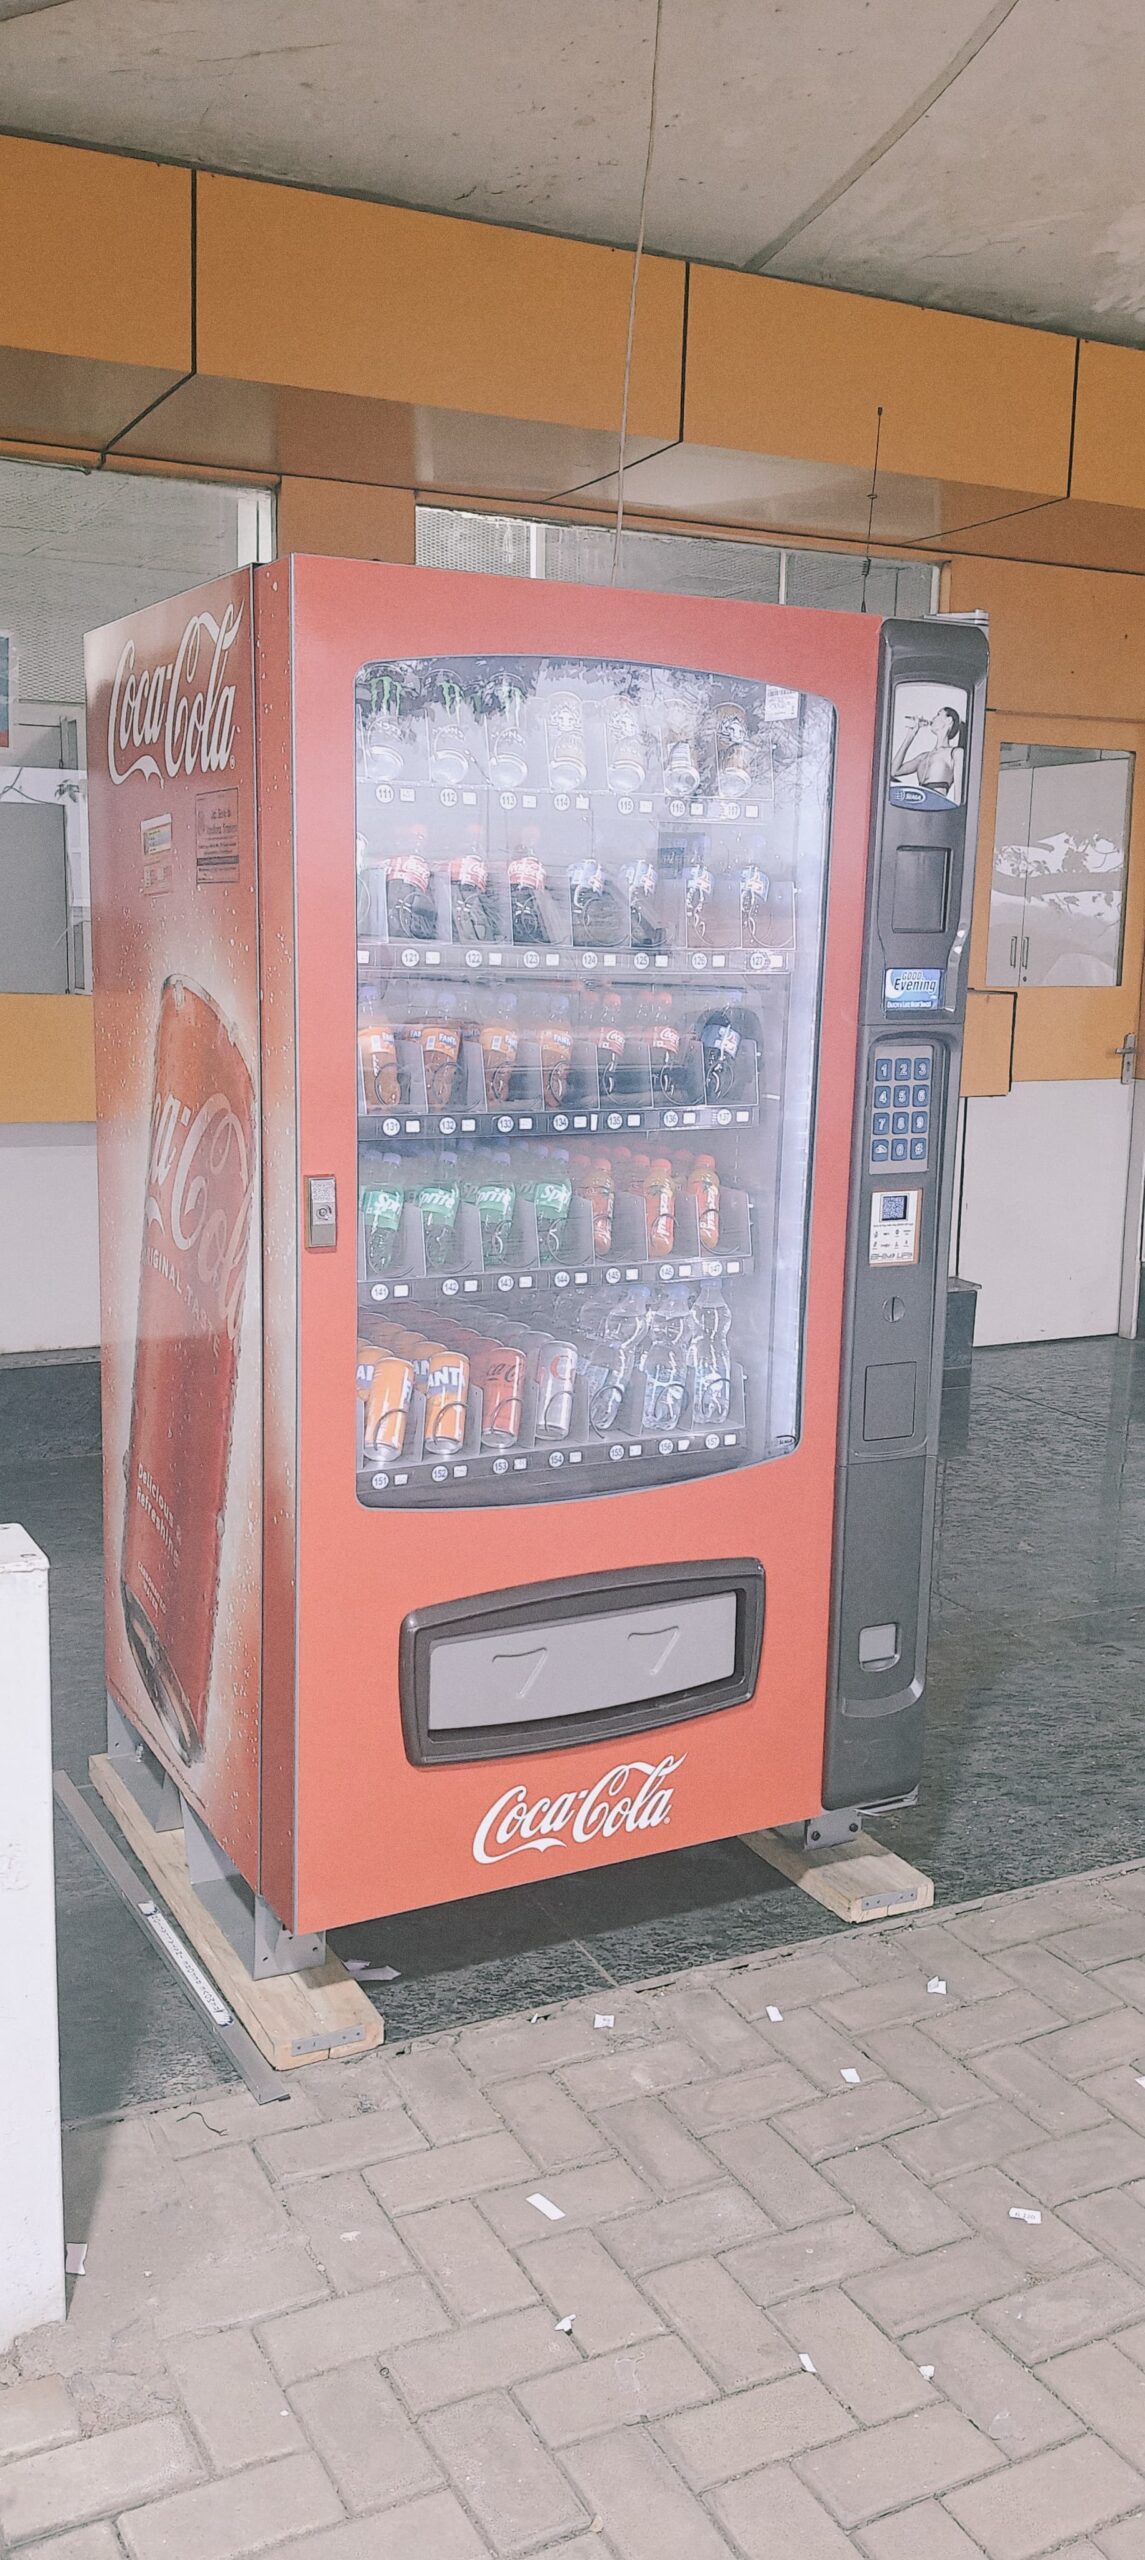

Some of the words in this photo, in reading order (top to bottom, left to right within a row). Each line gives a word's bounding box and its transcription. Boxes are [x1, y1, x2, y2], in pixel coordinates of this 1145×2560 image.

[108, 598, 244, 786] Coca-Cola
[379, 789, 392, 799] 111
[442, 792, 455, 802] 112
[502, 796, 515, 805] 113
[556, 797, 568, 807] 114
[619, 801, 632, 810] 115
[404, 953, 417, 962] 121
[468, 954, 480, 963] 122
[526, 955, 538, 963] 123
[584, 956, 596, 964] 124
[636, 957, 647, 965] 125
[694, 957, 705, 965] 126
[752, 957, 764, 965] 127
[894, 978, 936, 993] Evening
[880, 1063, 888, 1077] 1
[899, 1063, 908, 1076] 2
[918, 1062, 927, 1076] 3
[879, 1090, 888, 1104] 4
[898, 1089, 907, 1103] 5
[917, 1088, 926, 1102] 6
[386, 1122, 398, 1131] 131
[442, 1121, 454, 1130] 132
[500, 1119, 512, 1128] 133
[555, 1118, 567, 1127] 134
[610, 1116, 621, 1125] 135
[665, 1115, 676, 1123] 136
[878, 1117, 887, 1131] 7
[897, 1116, 906, 1130] 8
[916, 1116, 924, 1129] 9
[895, 1142, 905, 1157] 0
[374, 1287, 387, 1297] 141
[445, 1282, 457, 1292] 142
[500, 1279, 512, 1288] 143
[374, 1476, 387, 1486] 151
[433, 1470, 446, 1479] 152
[494, 1461, 507, 1471] 153
[551, 1455, 562, 1463] 154
[611, 1448, 622, 1456] 155
[660, 1443, 671, 1451] 156
[707, 1437, 718, 1446] 157
[473, 1752, 688, 1865] Coca-Cola
